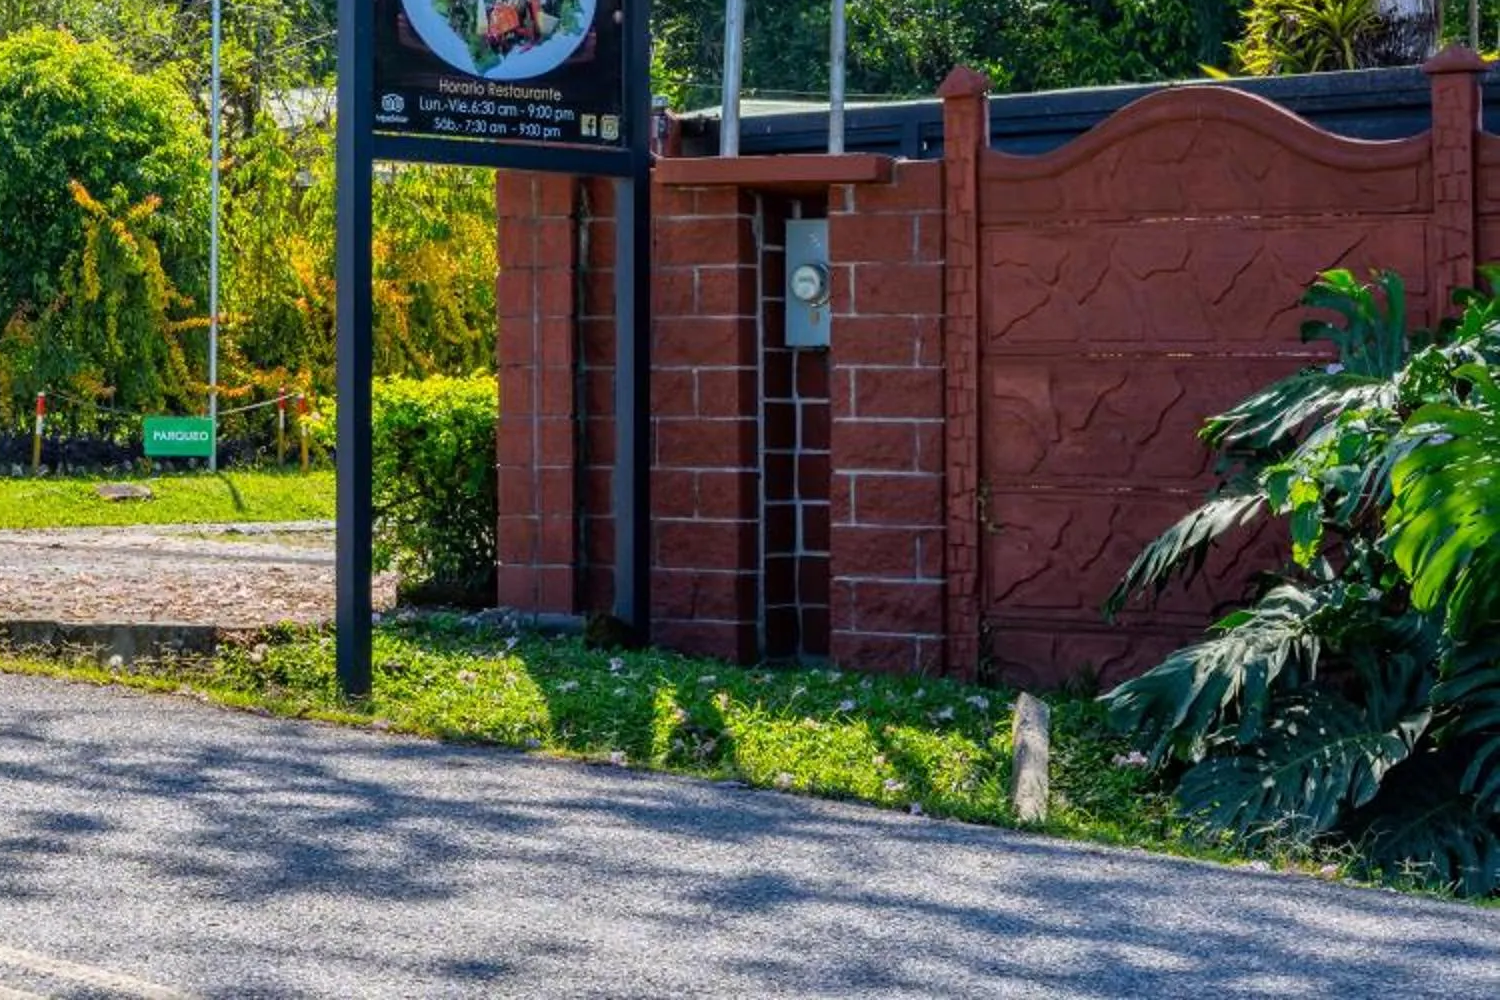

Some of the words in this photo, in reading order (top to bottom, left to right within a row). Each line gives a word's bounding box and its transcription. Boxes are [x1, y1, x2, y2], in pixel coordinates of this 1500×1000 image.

[439, 79, 485, 96] Horario
[488, 83, 563, 101] Restaurante
[497, 104, 518, 116] am
[527, 103, 551, 120] 9:00
[554, 107, 575, 121] pm
[153, 430, 209, 441] PARQUEO
